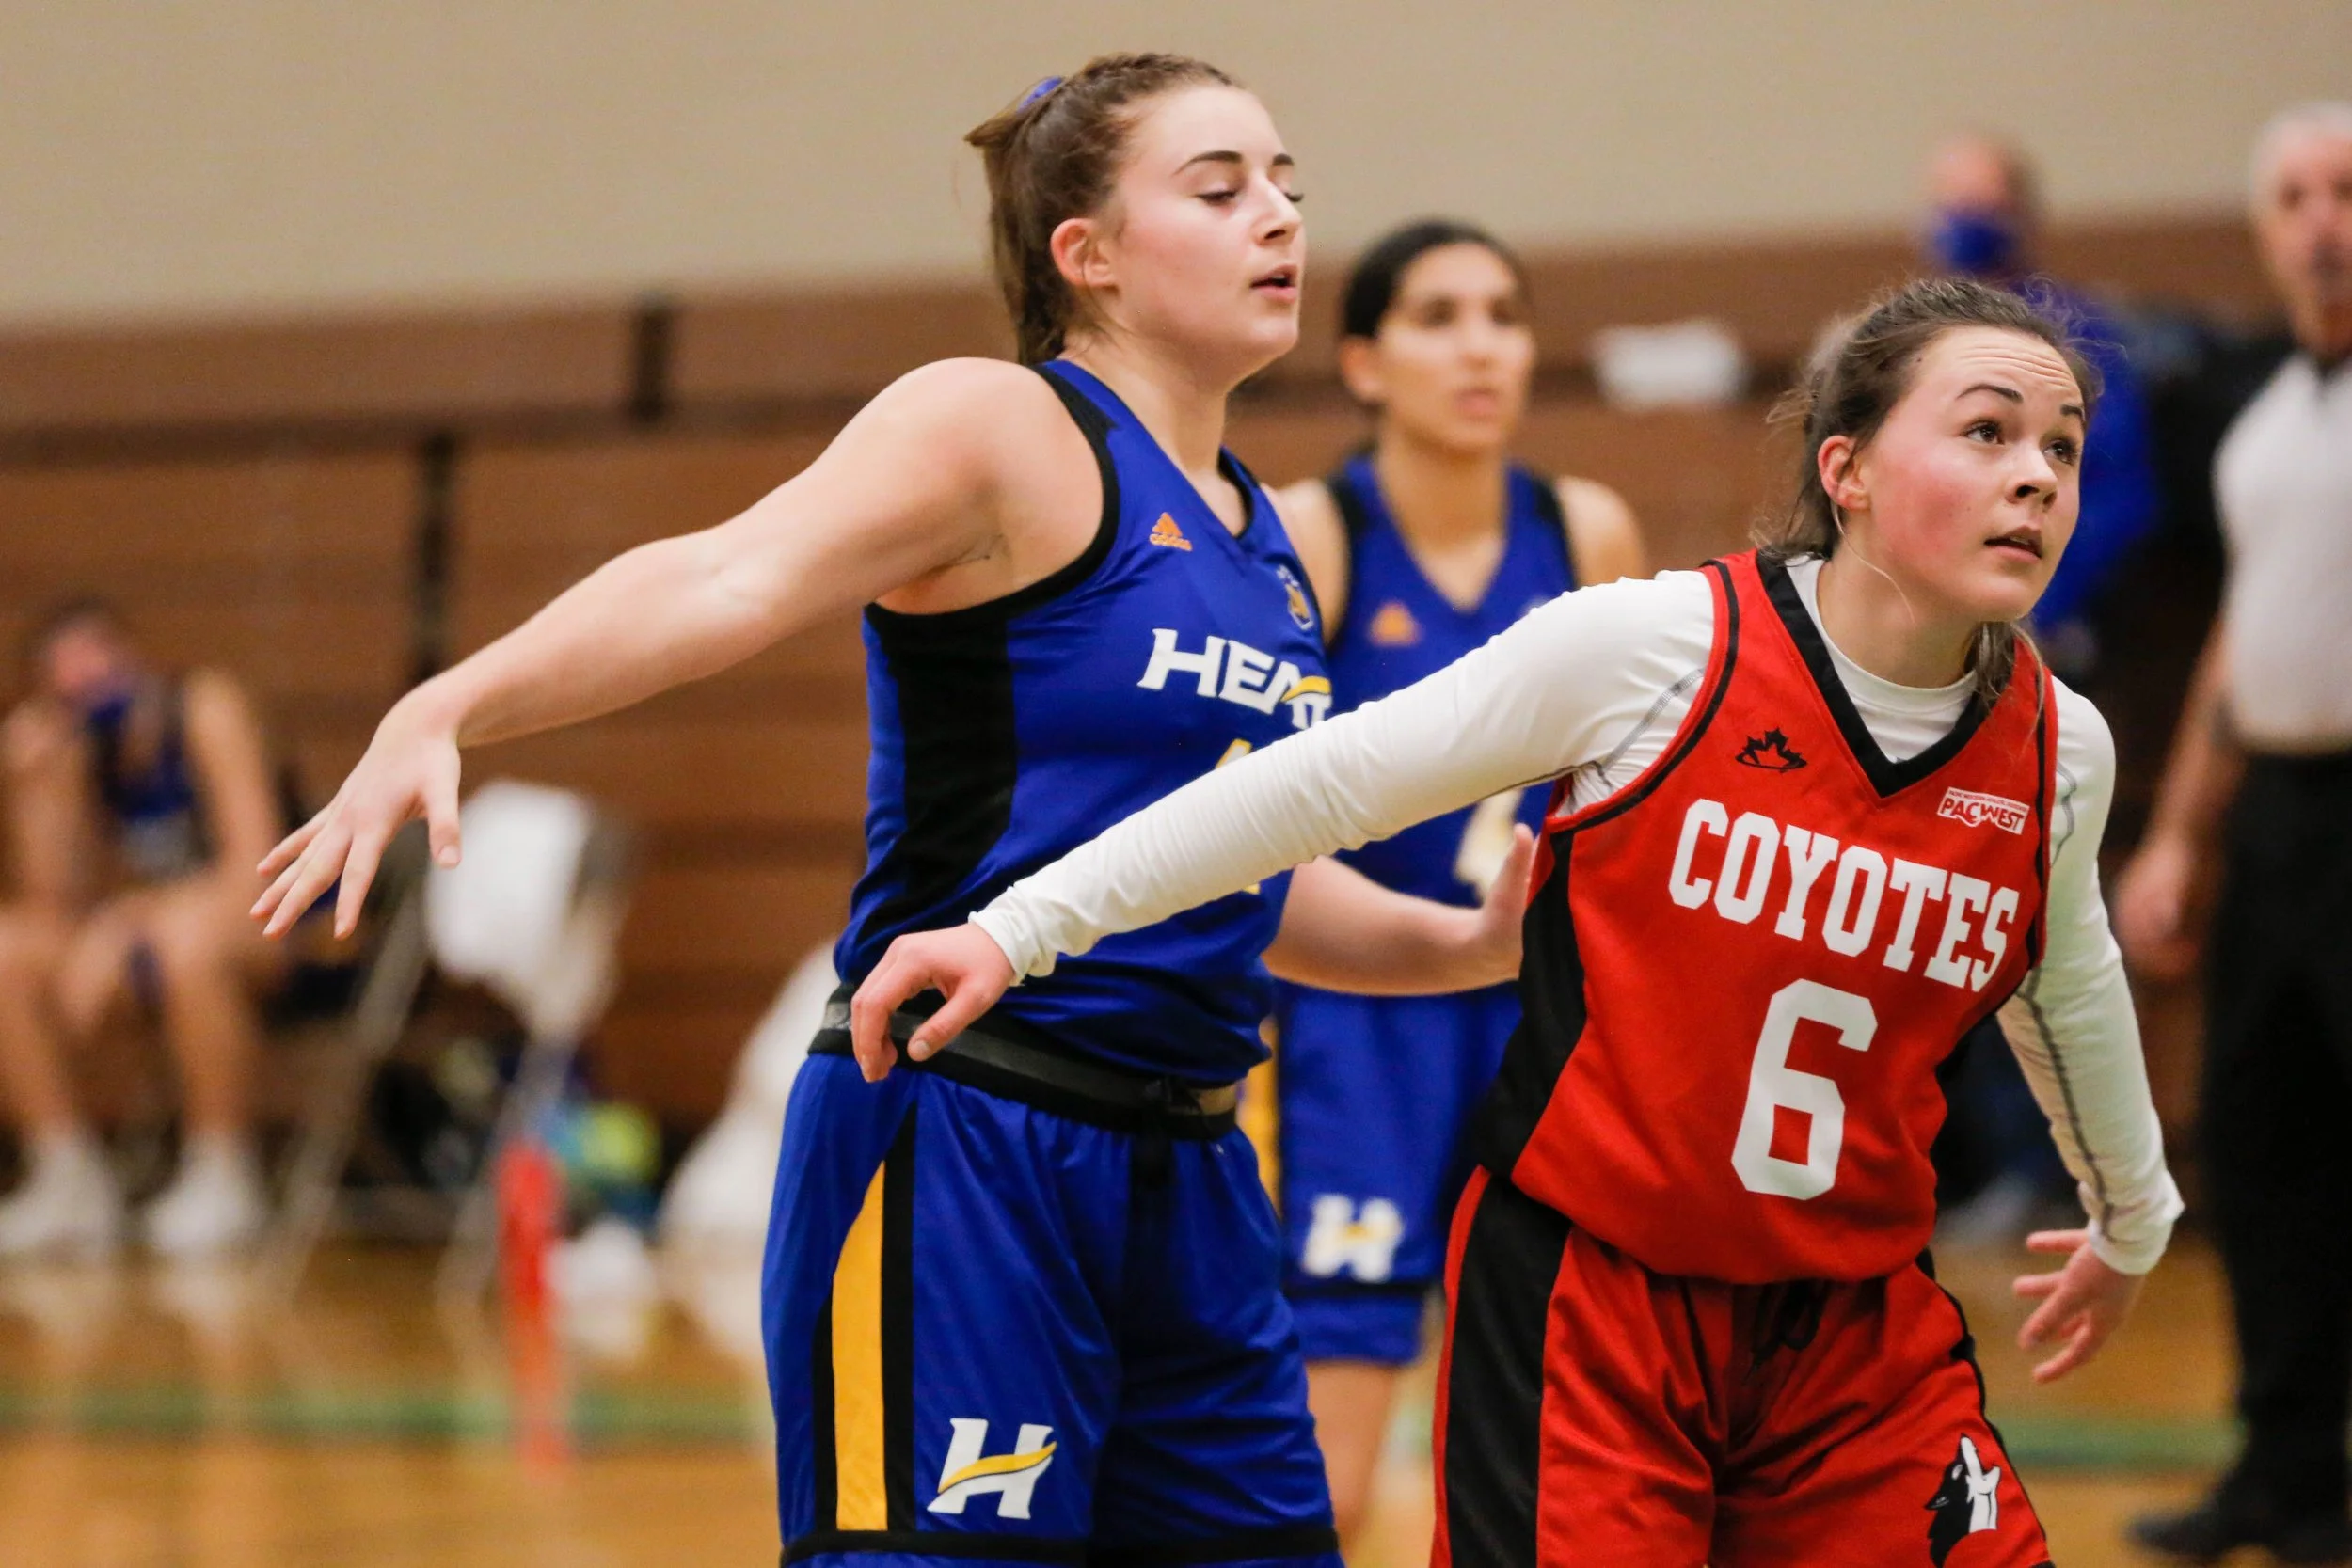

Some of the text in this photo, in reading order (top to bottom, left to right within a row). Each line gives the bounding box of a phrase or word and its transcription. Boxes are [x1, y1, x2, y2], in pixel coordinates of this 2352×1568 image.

[1940, 798, 2024, 831] PACWEST
[1668, 798, 2020, 992] COYOTES
[1731, 978, 1878, 1201] 6
[927, 1418, 1057, 1519] H
